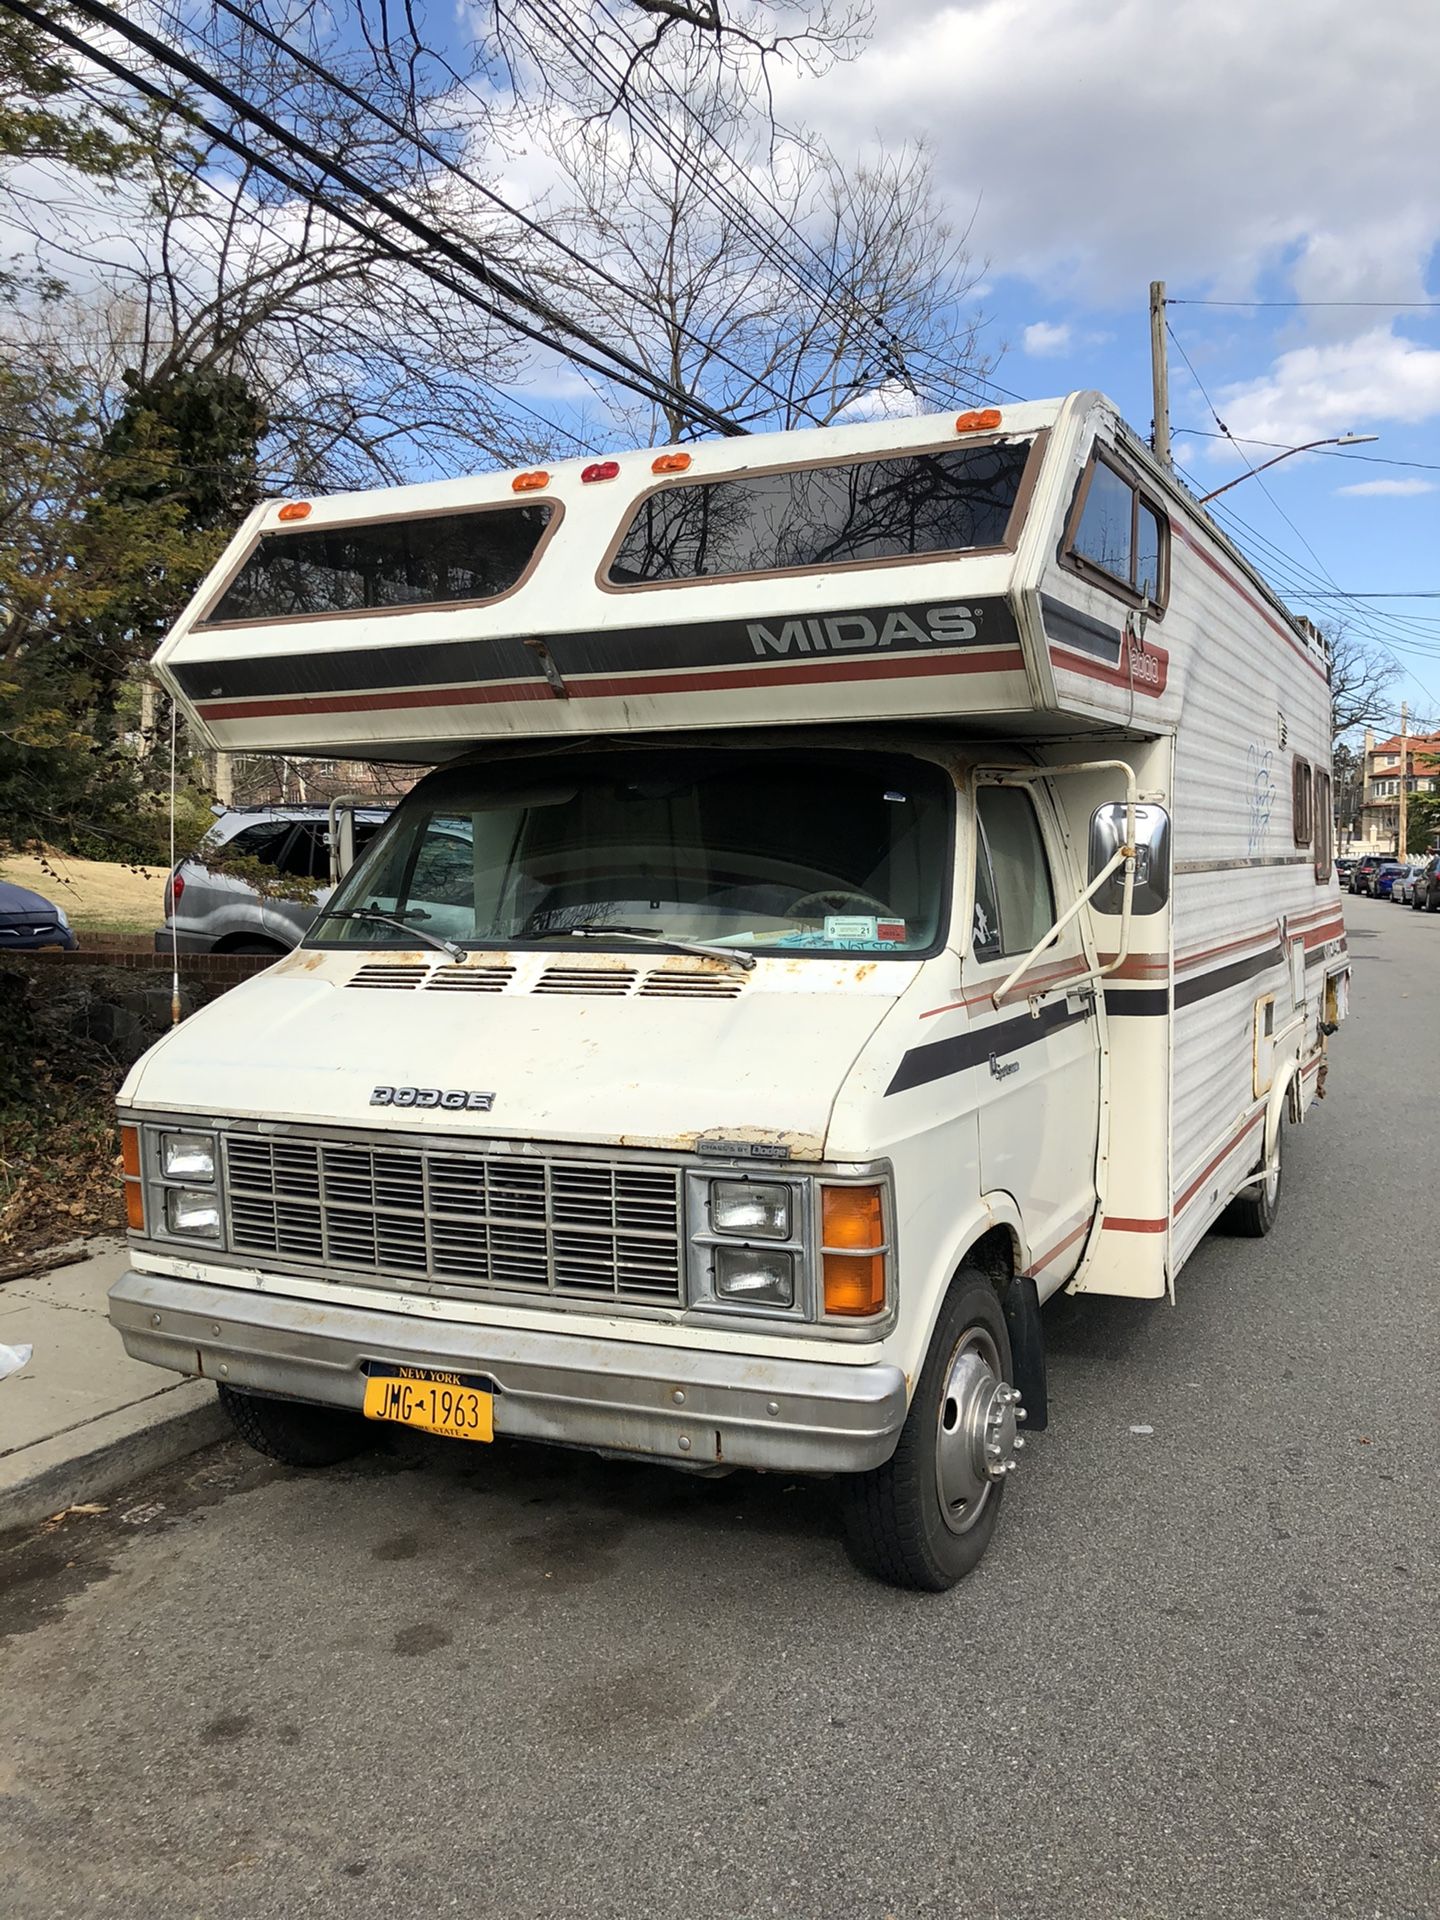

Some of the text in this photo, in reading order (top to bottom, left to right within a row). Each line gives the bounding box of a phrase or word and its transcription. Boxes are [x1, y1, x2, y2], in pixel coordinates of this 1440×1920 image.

[746, 606, 977, 656] MIDAS
[1130, 647, 1159, 684] 2000
[830, 927, 836, 935] 9
[860, 927, 871, 935] 21
[369, 1086, 497, 1112] DODGE
[737, 1146, 749, 1154] BY
[751, 1144, 788, 1158] Dodge
[399, 1367, 461, 1386] NEW YORK
[429, 1389, 479, 1428] 1963
[432, 1426, 462, 1438] STATE
